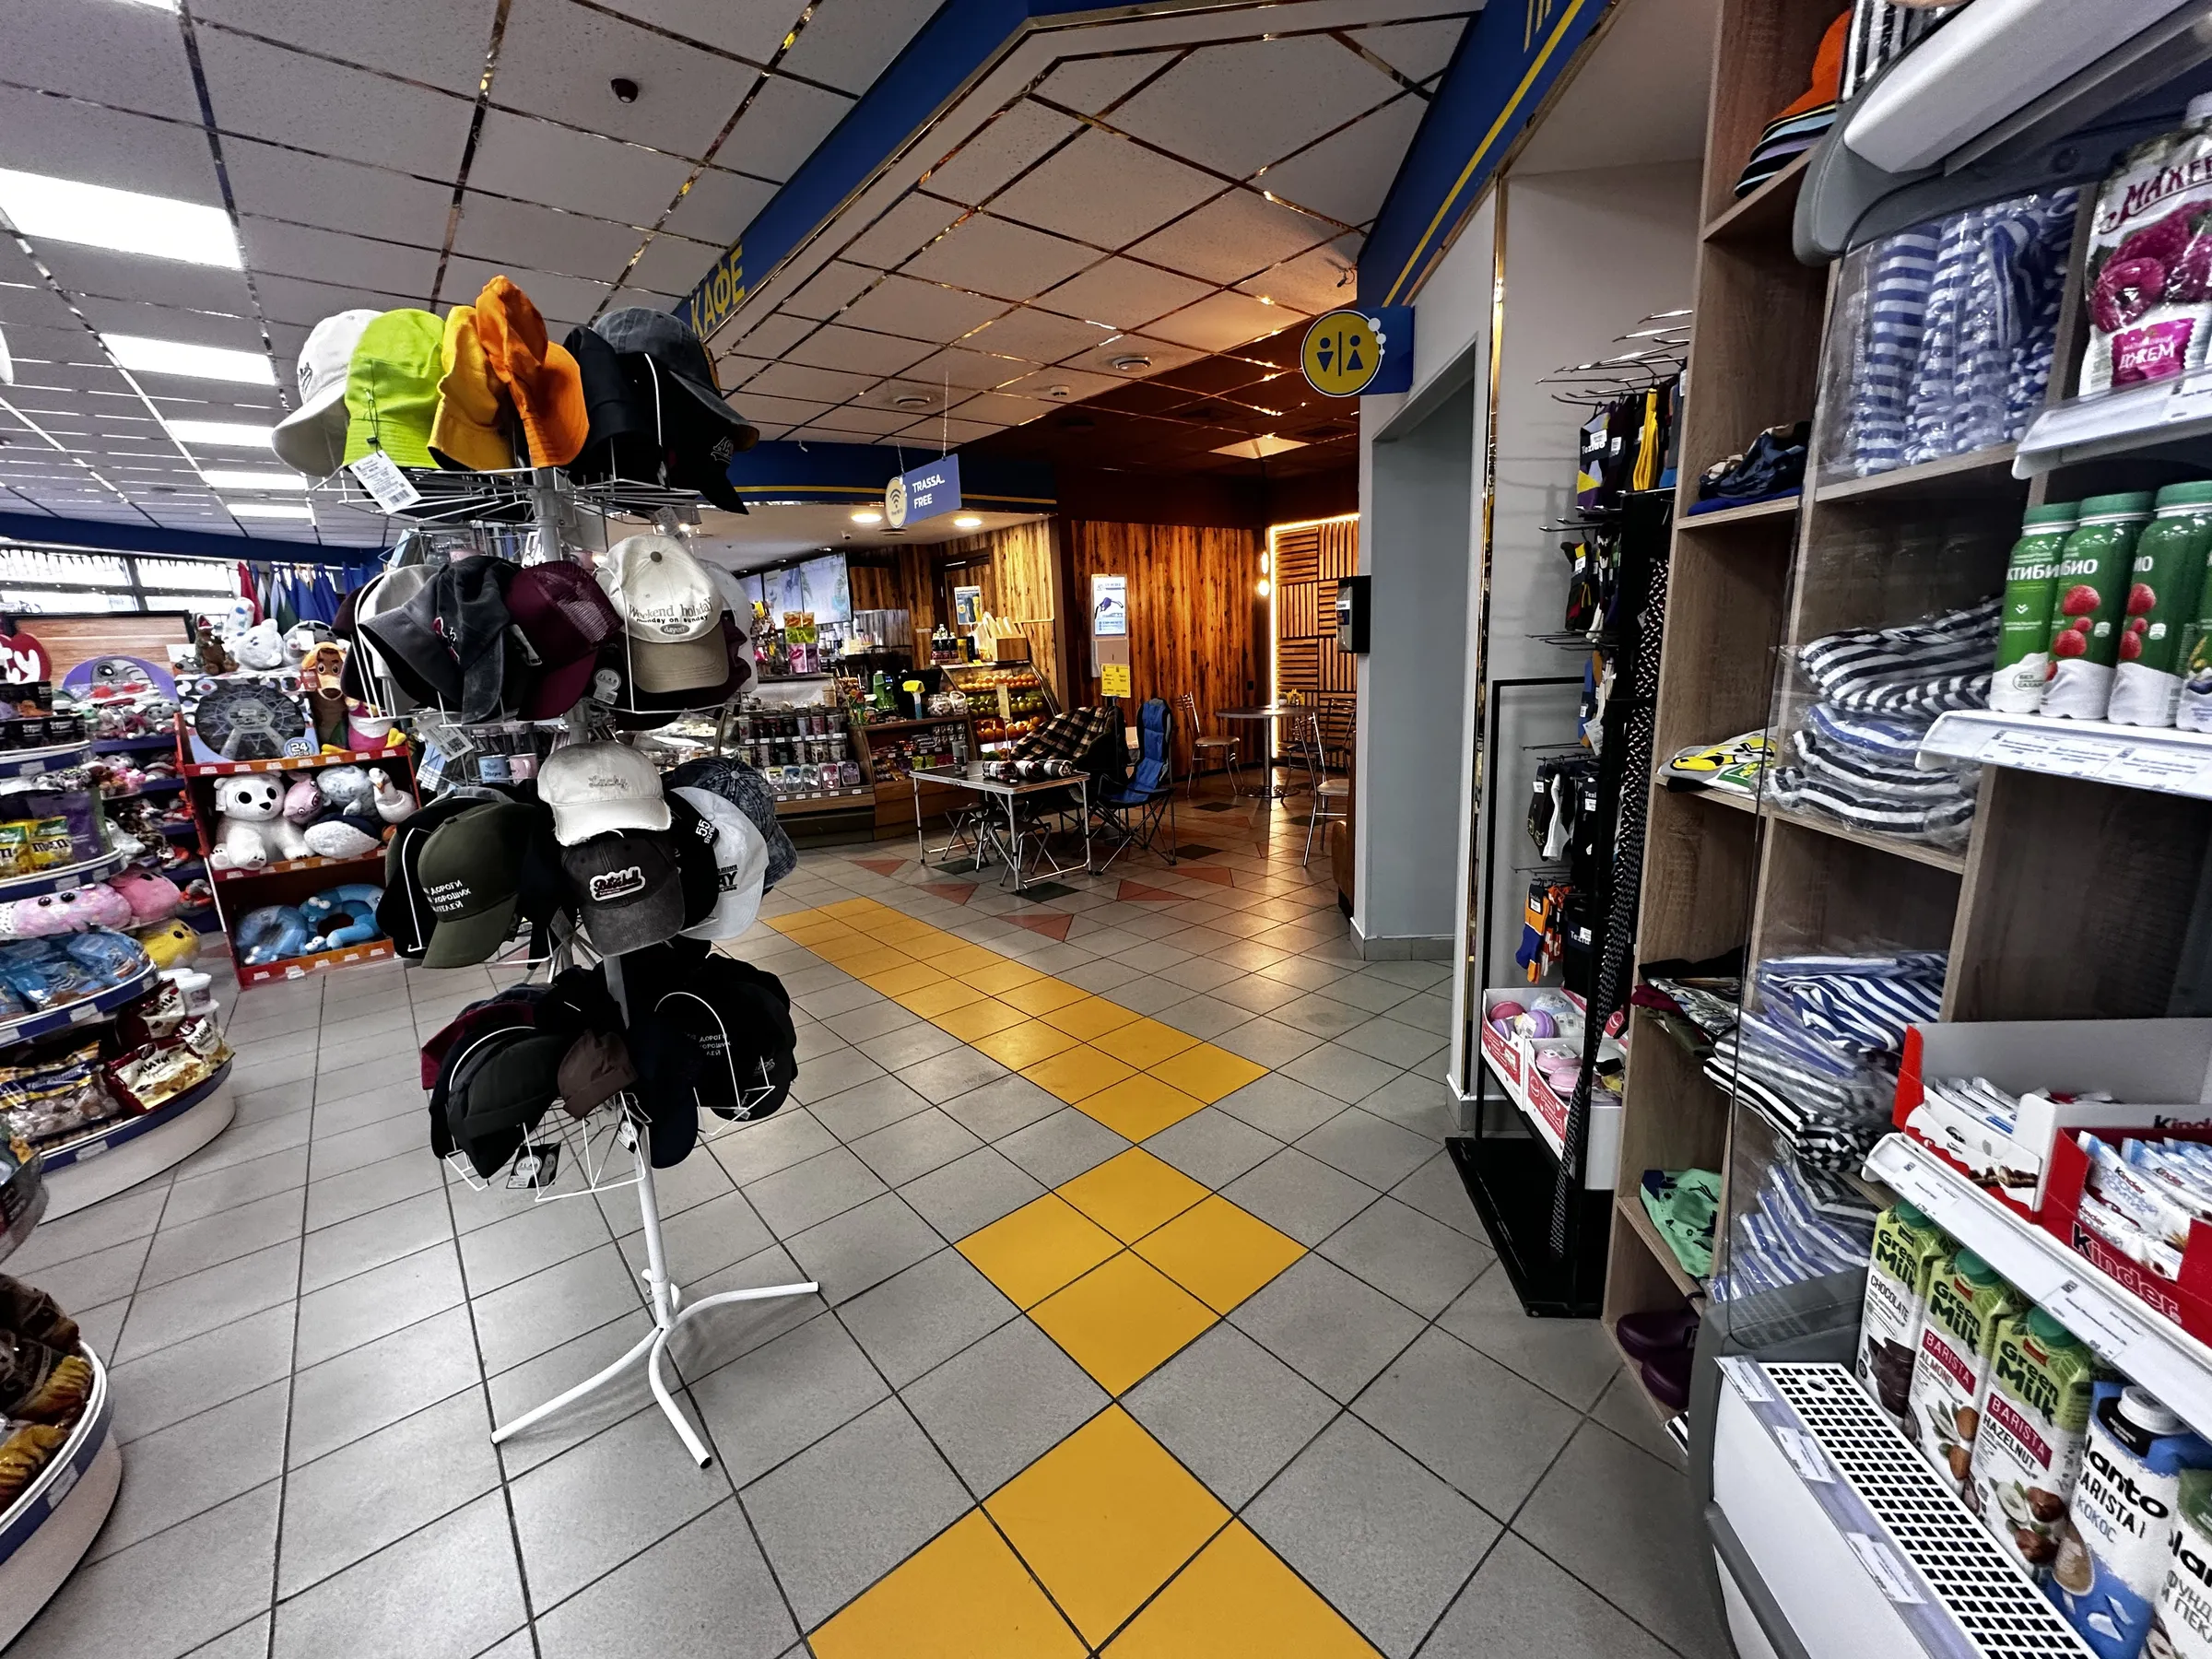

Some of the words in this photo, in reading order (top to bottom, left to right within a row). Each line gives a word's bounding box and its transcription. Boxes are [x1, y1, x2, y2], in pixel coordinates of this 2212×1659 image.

[690, 244, 745, 337] КАФЕ
[913, 493, 933, 509] FREE
[629, 604, 675, 620] Weekend
[290, 742, 309, 753] 24
[695, 819, 711, 837] 55
[430, 879, 463, 895] ДОРОГИ
[432, 888, 472, 903] ХОРОШИХ
[1876, 1241, 1916, 1295] Milk
[1878, 1229, 1917, 1277] Green
[1870, 1275, 1910, 1323] CHOCOLATE
[1933, 1279, 1981, 1336] Green
[1929, 1293, 1978, 1357] Milk
[1919, 1349, 1954, 1388] ALMOND
[1926, 1333, 1970, 1383] BARISTA
[2000, 1340, 2059, 1406] Green
[1995, 1355, 2055, 1428] Milk
[1983, 1413, 2037, 1470] HAZELNUT
[1992, 1396, 2045, 1457] BARISTA
[2077, 1494, 2117, 1544] КОКОС
